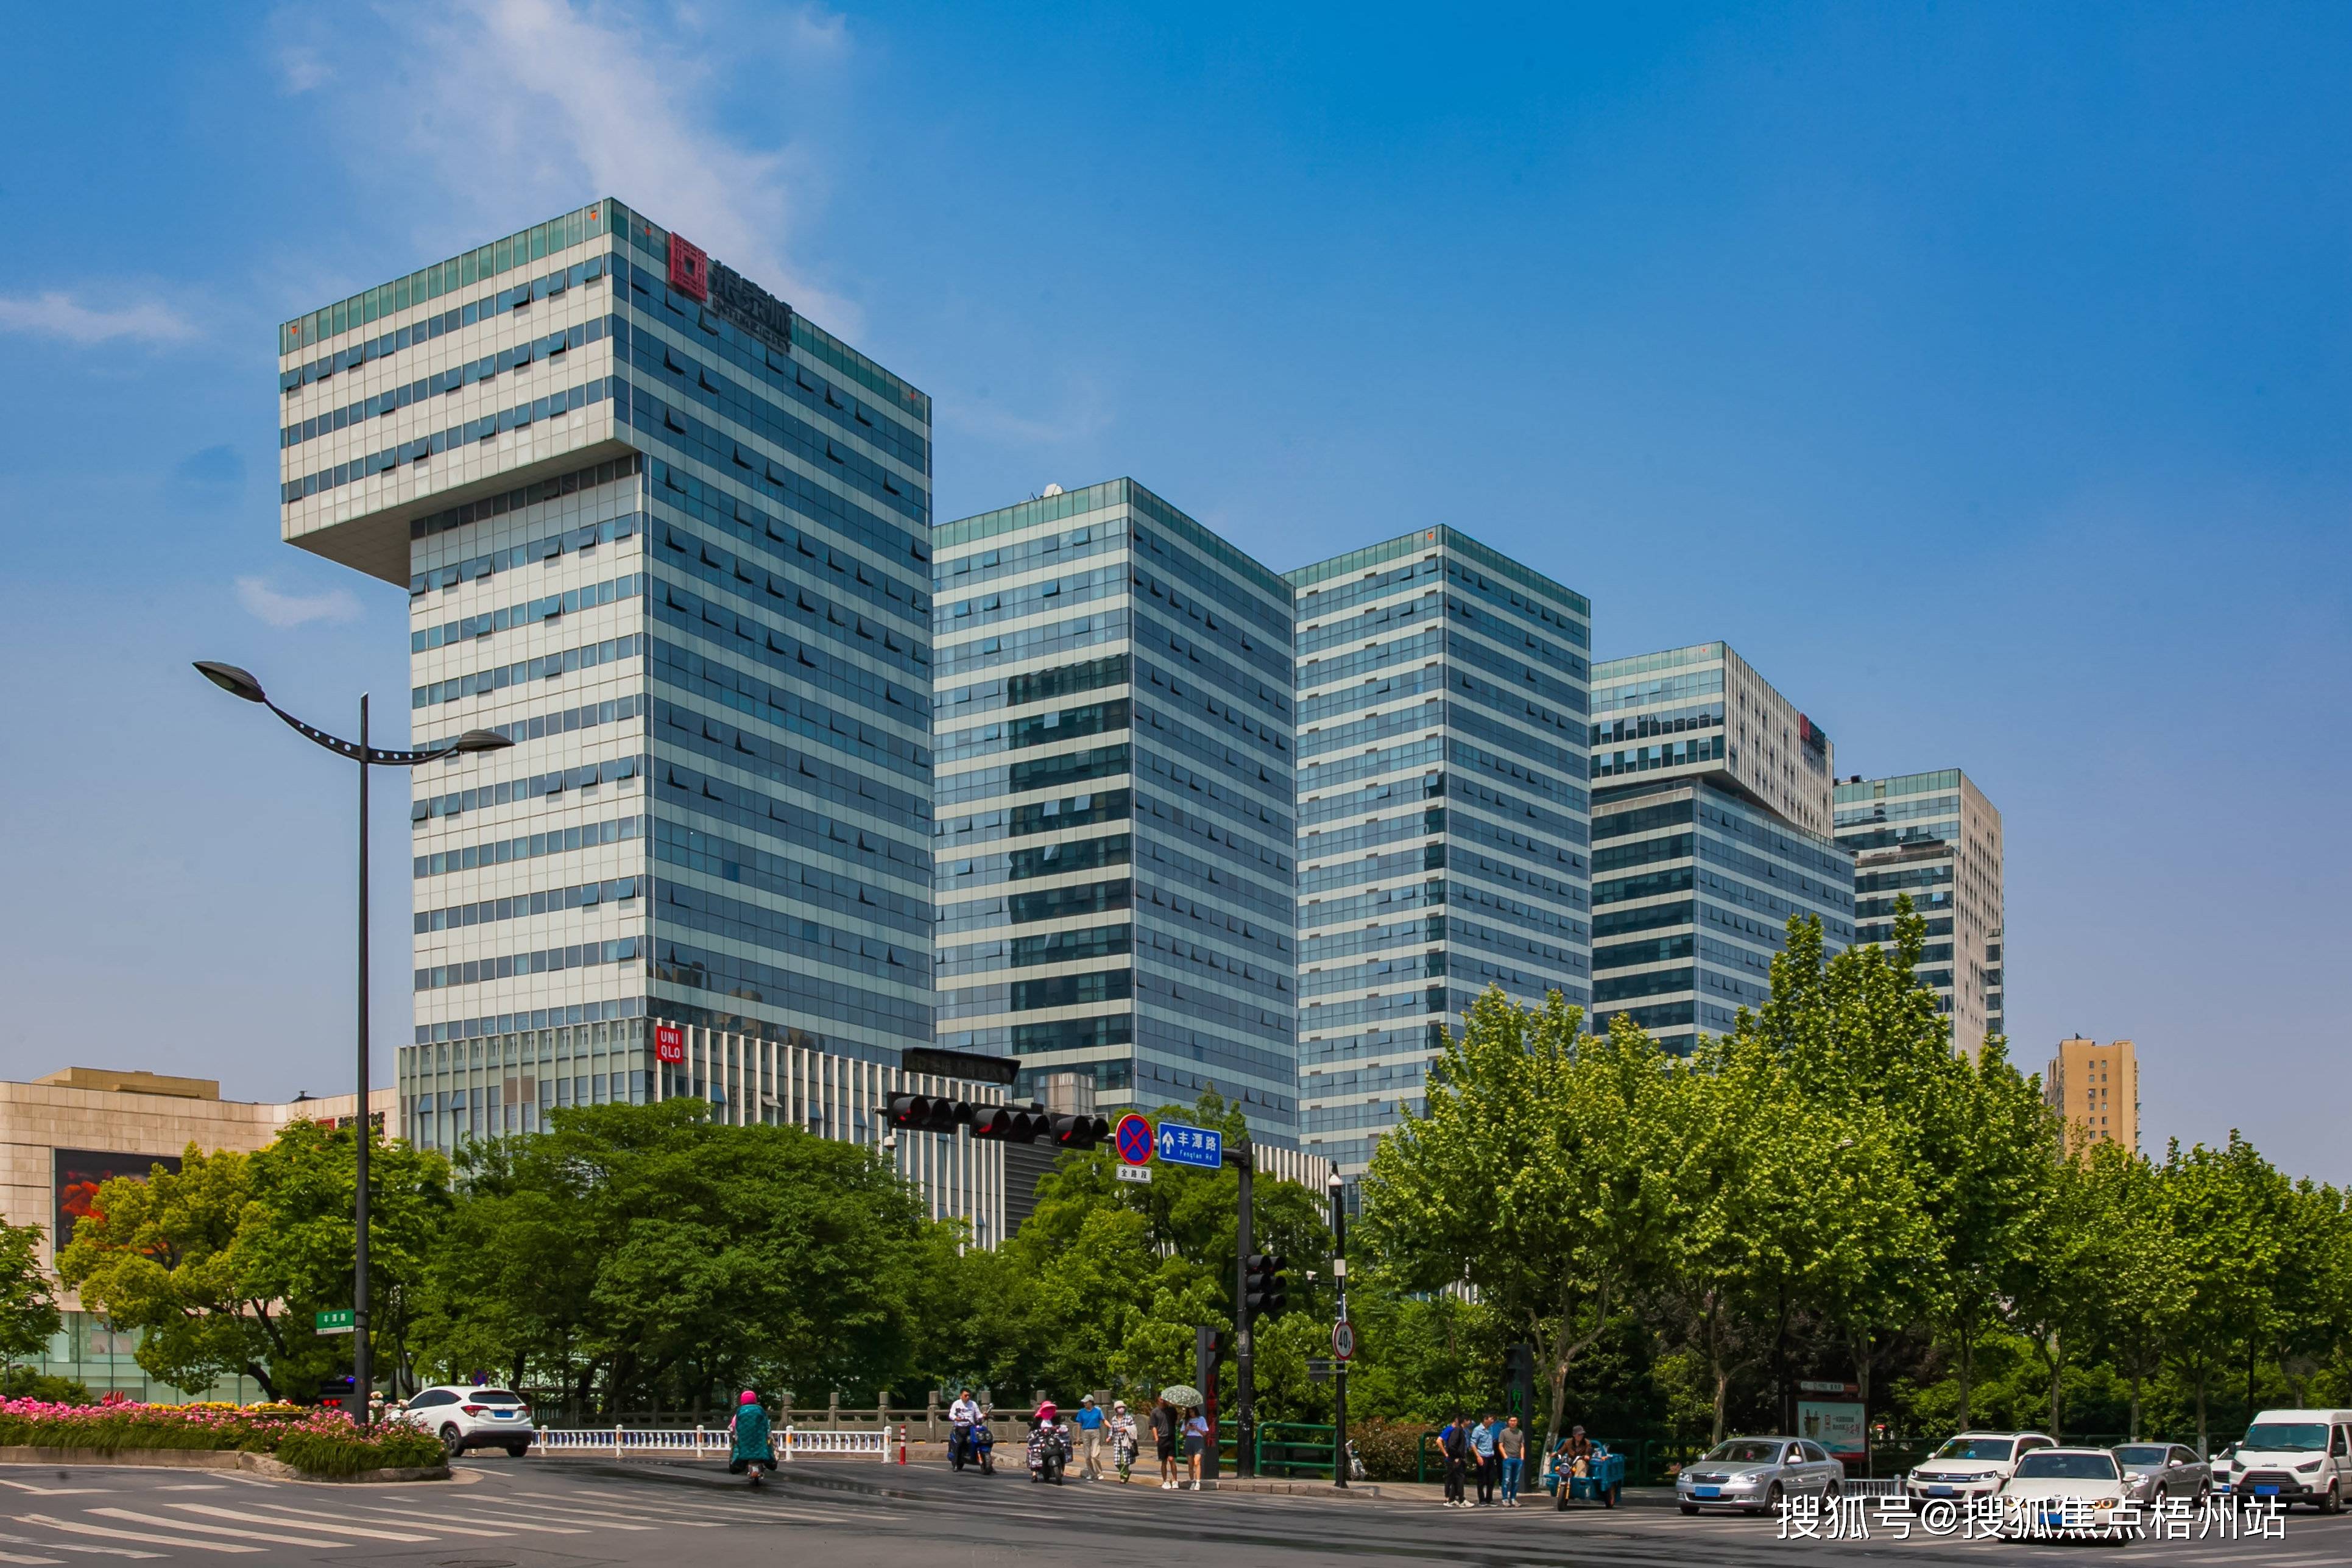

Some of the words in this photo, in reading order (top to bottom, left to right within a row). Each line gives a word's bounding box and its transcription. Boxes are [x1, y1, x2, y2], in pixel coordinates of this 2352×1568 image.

[660, 1030, 679, 1045] UNI
[661, 1045, 680, 1059] QLO
[1178, 1131, 1217, 1151] 丰潭路
[1121, 1168, 1148, 1179] 全路段
